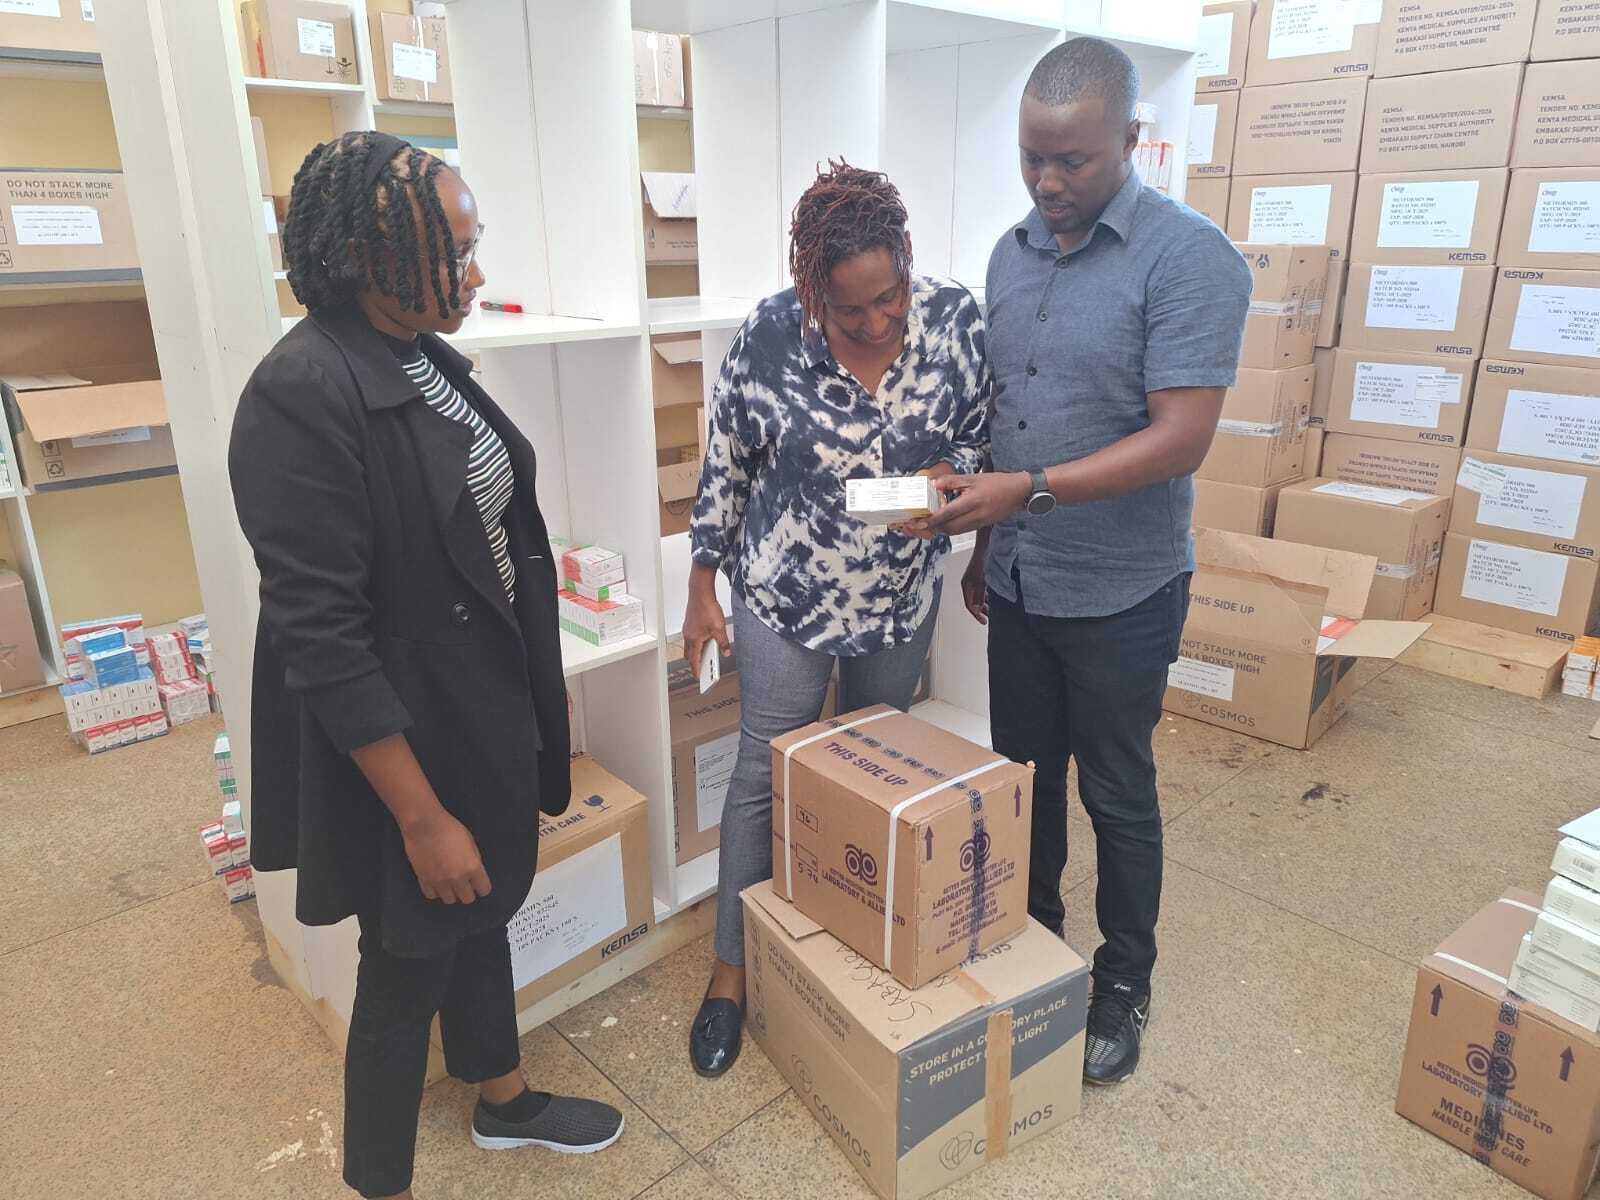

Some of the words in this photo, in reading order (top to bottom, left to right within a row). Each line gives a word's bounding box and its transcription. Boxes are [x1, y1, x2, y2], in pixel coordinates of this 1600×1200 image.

[7, 180, 22, 188] DO
[25, 180, 45, 188] NOT
[85, 182, 113, 190] MORE
[48, 191, 82, 199] BOXES
[1213, 600, 1237, 612] SIDE
[1239, 604, 1255, 615] UP
[1203, 643, 1237, 657] STACK
[1238, 651, 1267, 664] MORE
[1235, 662, 1261, 674] HIGH
[1200, 704, 1256, 727] COSMOS
[824, 742, 857, 760] THIS
[853, 758, 888, 777] SIDE
[883, 774, 909, 786] UP
[558, 812, 586, 829] CARE
[822, 869, 860, 901] LABORATORY
[892, 913, 906, 927] LTD
[780, 956, 795, 975] NOT
[797, 972, 823, 1001] STACK
[825, 1002, 850, 1034] MORE
[795, 985, 823, 1018] BOXES
[910, 1050, 949, 1079] STORE
[951, 1044, 964, 1058] IN
[966, 1042, 974, 1052] A
[1033, 996, 1070, 1019] PLACE
[929, 1052, 981, 1086] PROTECT
[1018, 1020, 1051, 1043] LIGHT
[1421, 1060, 1483, 1098] LABORATORY
[1532, 1118, 1554, 1135] LTD
[813, 1094, 872, 1168] COSMOS
[974, 1104, 1053, 1156] CMOS
[1431, 1108, 1472, 1137] HANDLE
[1501, 1146, 1532, 1168] CARE
